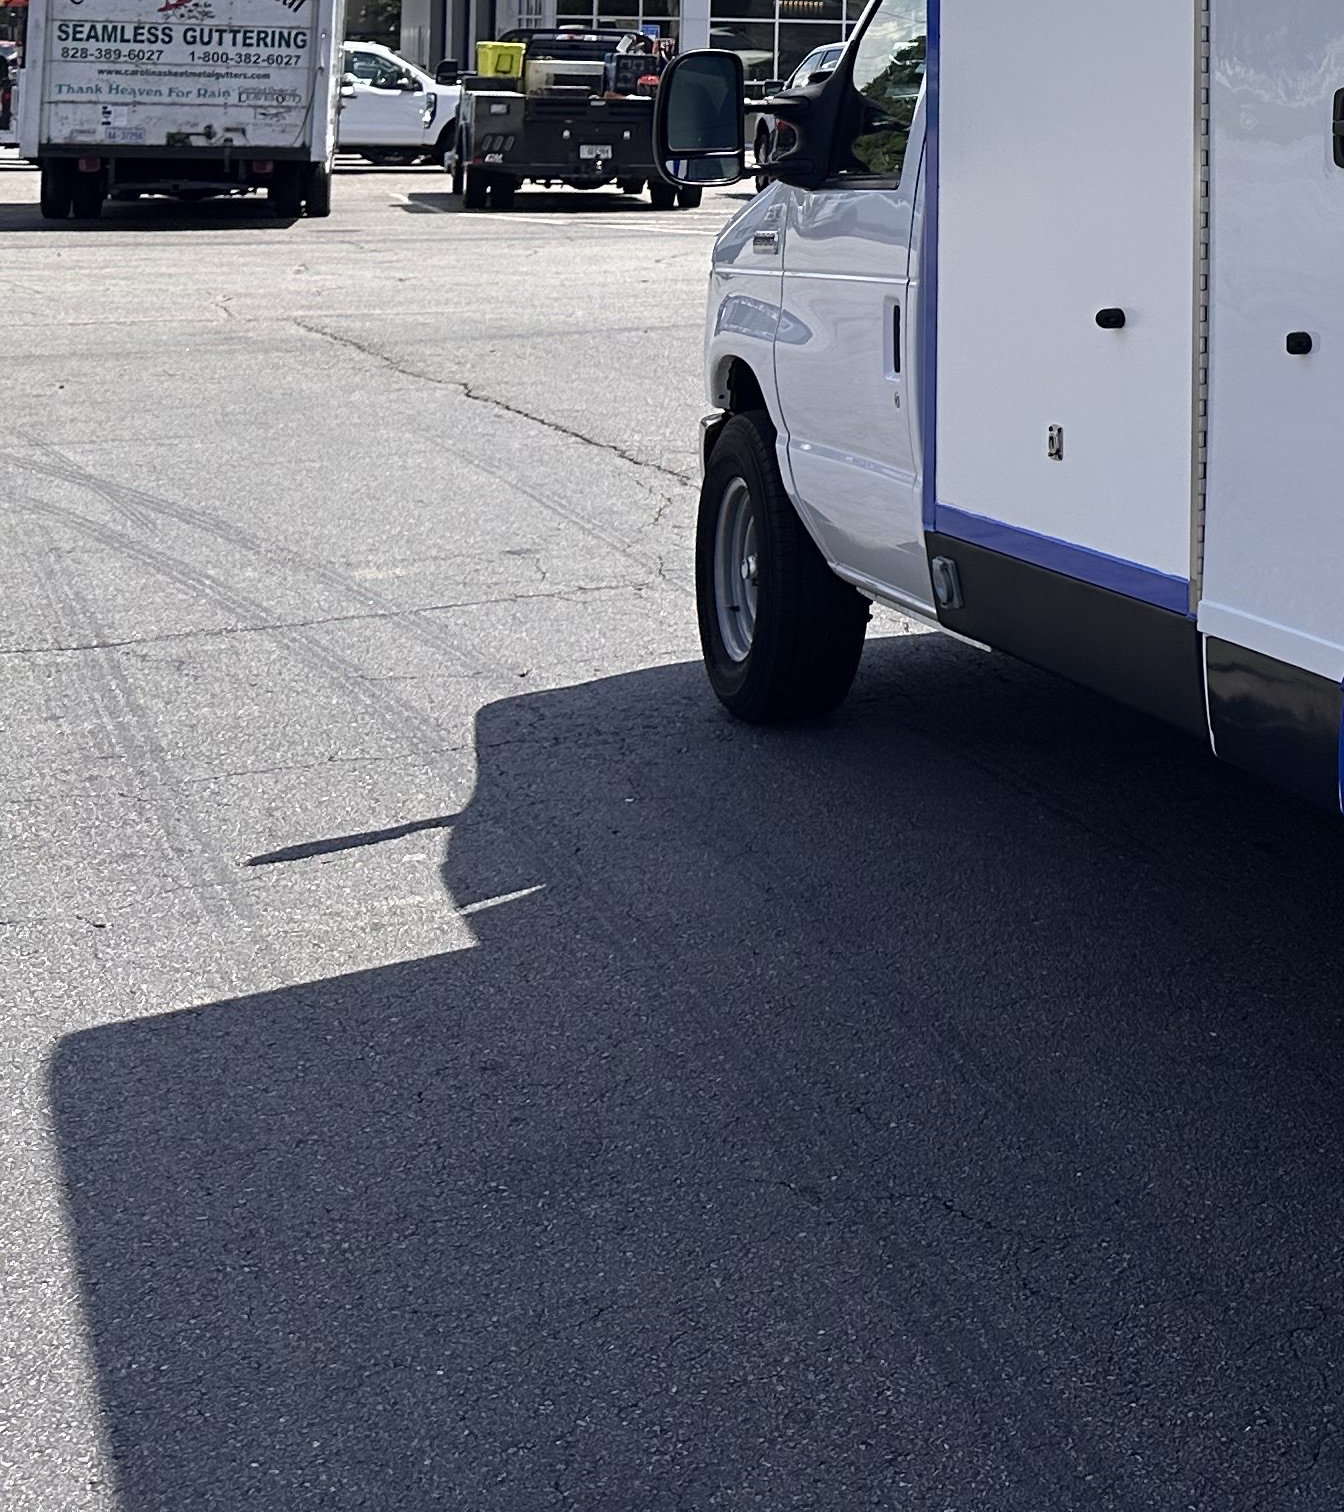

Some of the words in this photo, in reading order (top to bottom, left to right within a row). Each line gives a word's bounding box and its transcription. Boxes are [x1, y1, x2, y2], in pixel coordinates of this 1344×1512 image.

[57, 23, 173, 45] SEAMLESS
[183, 27, 307, 49] GUTTERING
[61, 47, 164, 61] 828-389-6027
[189, 51, 301, 66] 1-800-382-6027
[55, 84, 103, 95] Thank
[108, 84, 163, 98] Heaven
[167, 87, 192, 98] For
